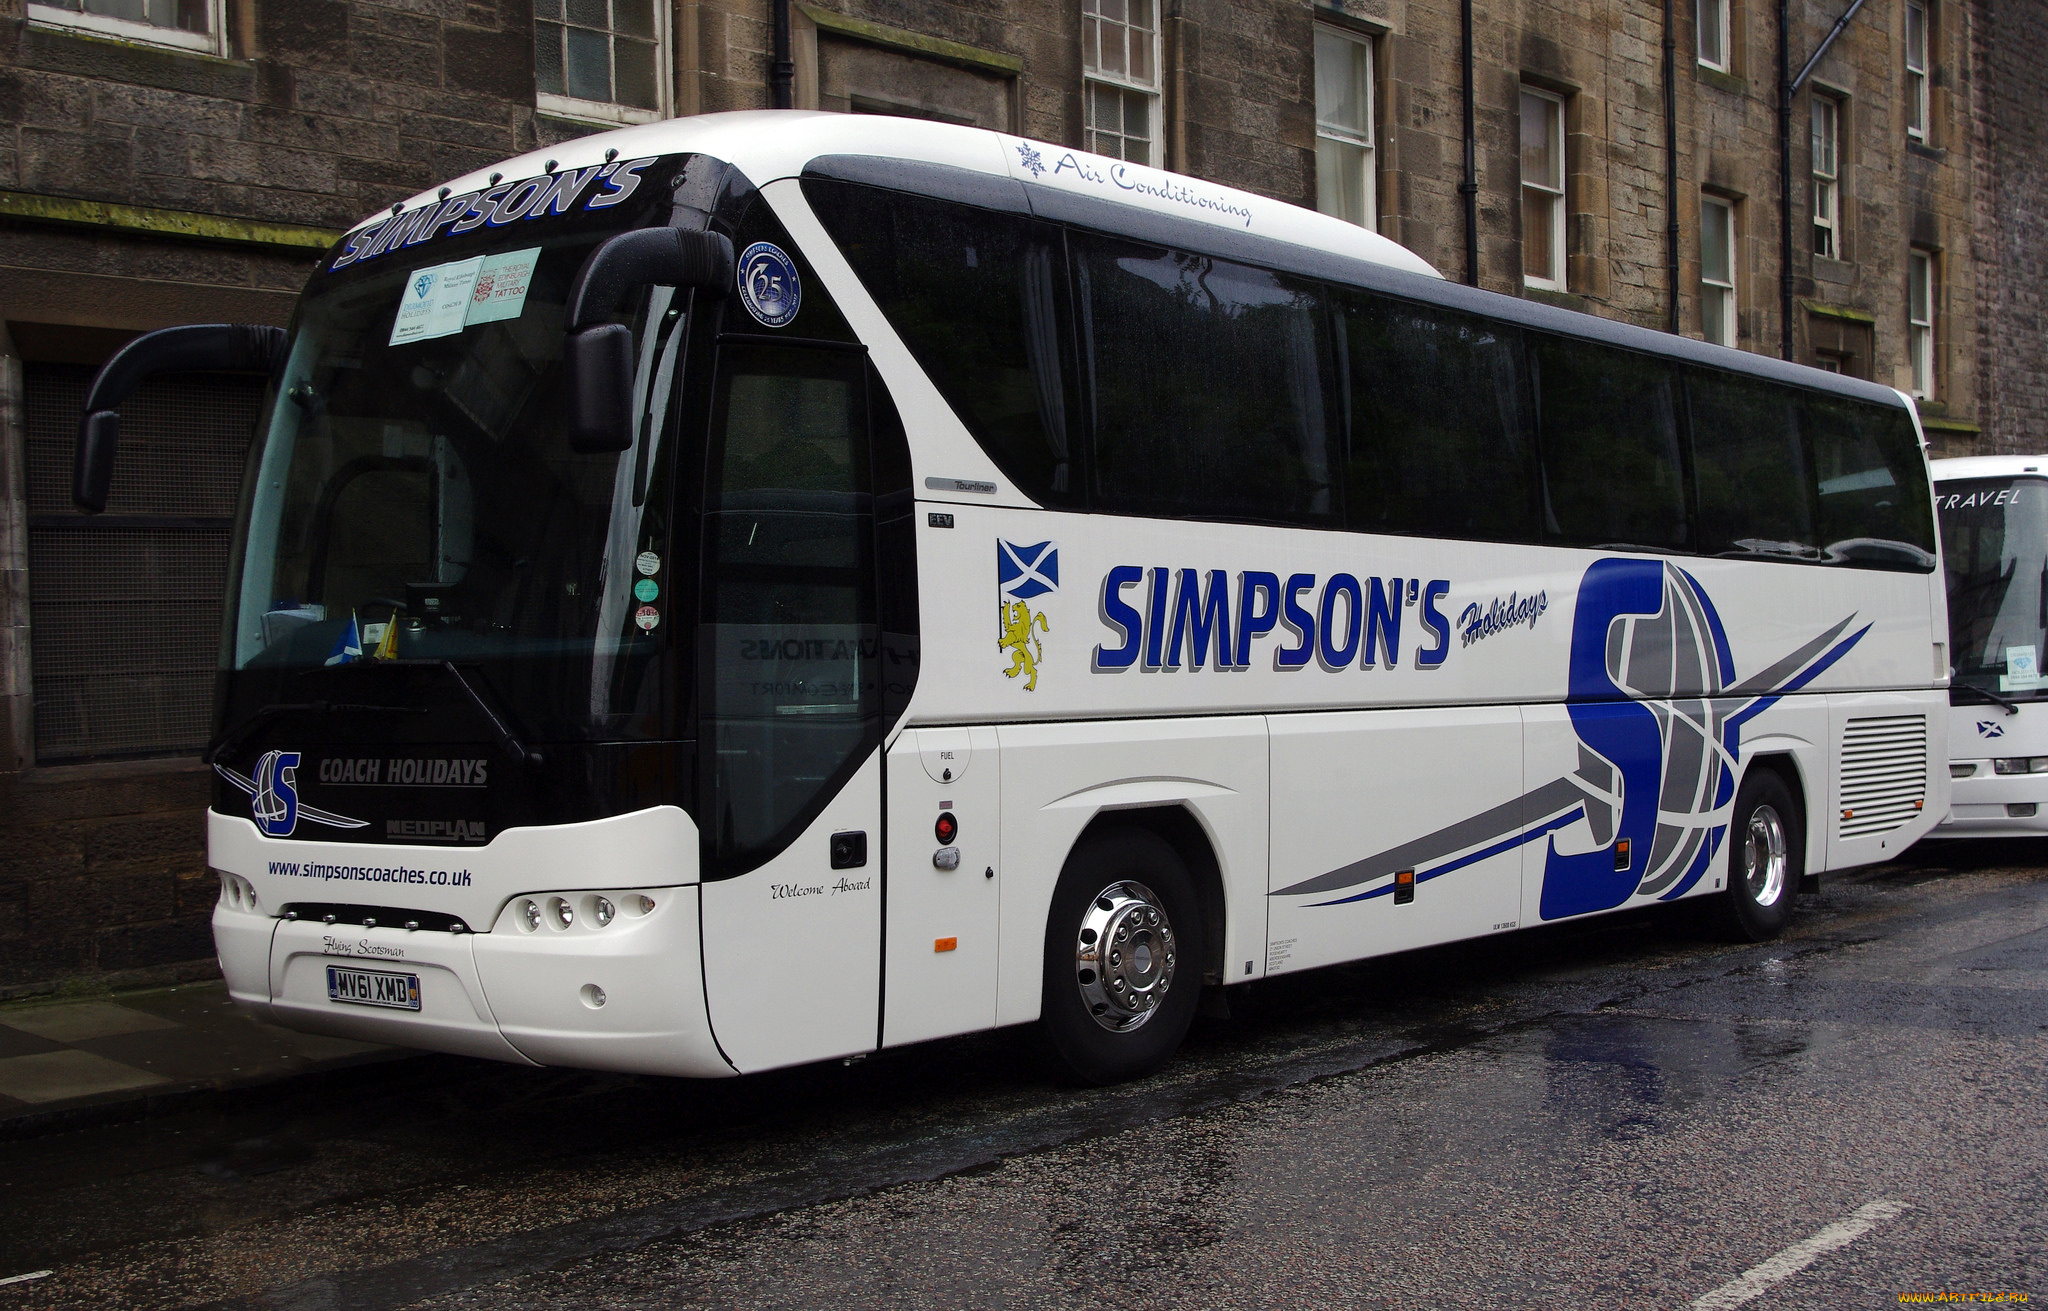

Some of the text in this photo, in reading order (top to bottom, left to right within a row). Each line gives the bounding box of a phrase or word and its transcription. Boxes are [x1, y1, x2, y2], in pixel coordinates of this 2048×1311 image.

[1054, 153, 1253, 228] Air Conditioning
[329, 156, 658, 272] SIMPSON'S
[494, 285, 526, 299] TATTOO
[757, 274, 782, 303] 25
[954, 480, 994, 492] Tourliner
[1935, 489, 2020, 510] TRAVEL
[930, 513, 953, 526] EEV
[1091, 565, 1548, 674] SIMPSON'S Holidays
[940, 751, 955, 760] FUEL
[320, 758, 488, 784] COACH HOLIDAYS
[387, 819, 486, 841] NEOPLAN
[268, 861, 472, 887] www.simpsonscoaches.co.uk
[771, 877, 871, 900] Welcome Aboard
[323, 935, 405, 958] Flying Scotsman
